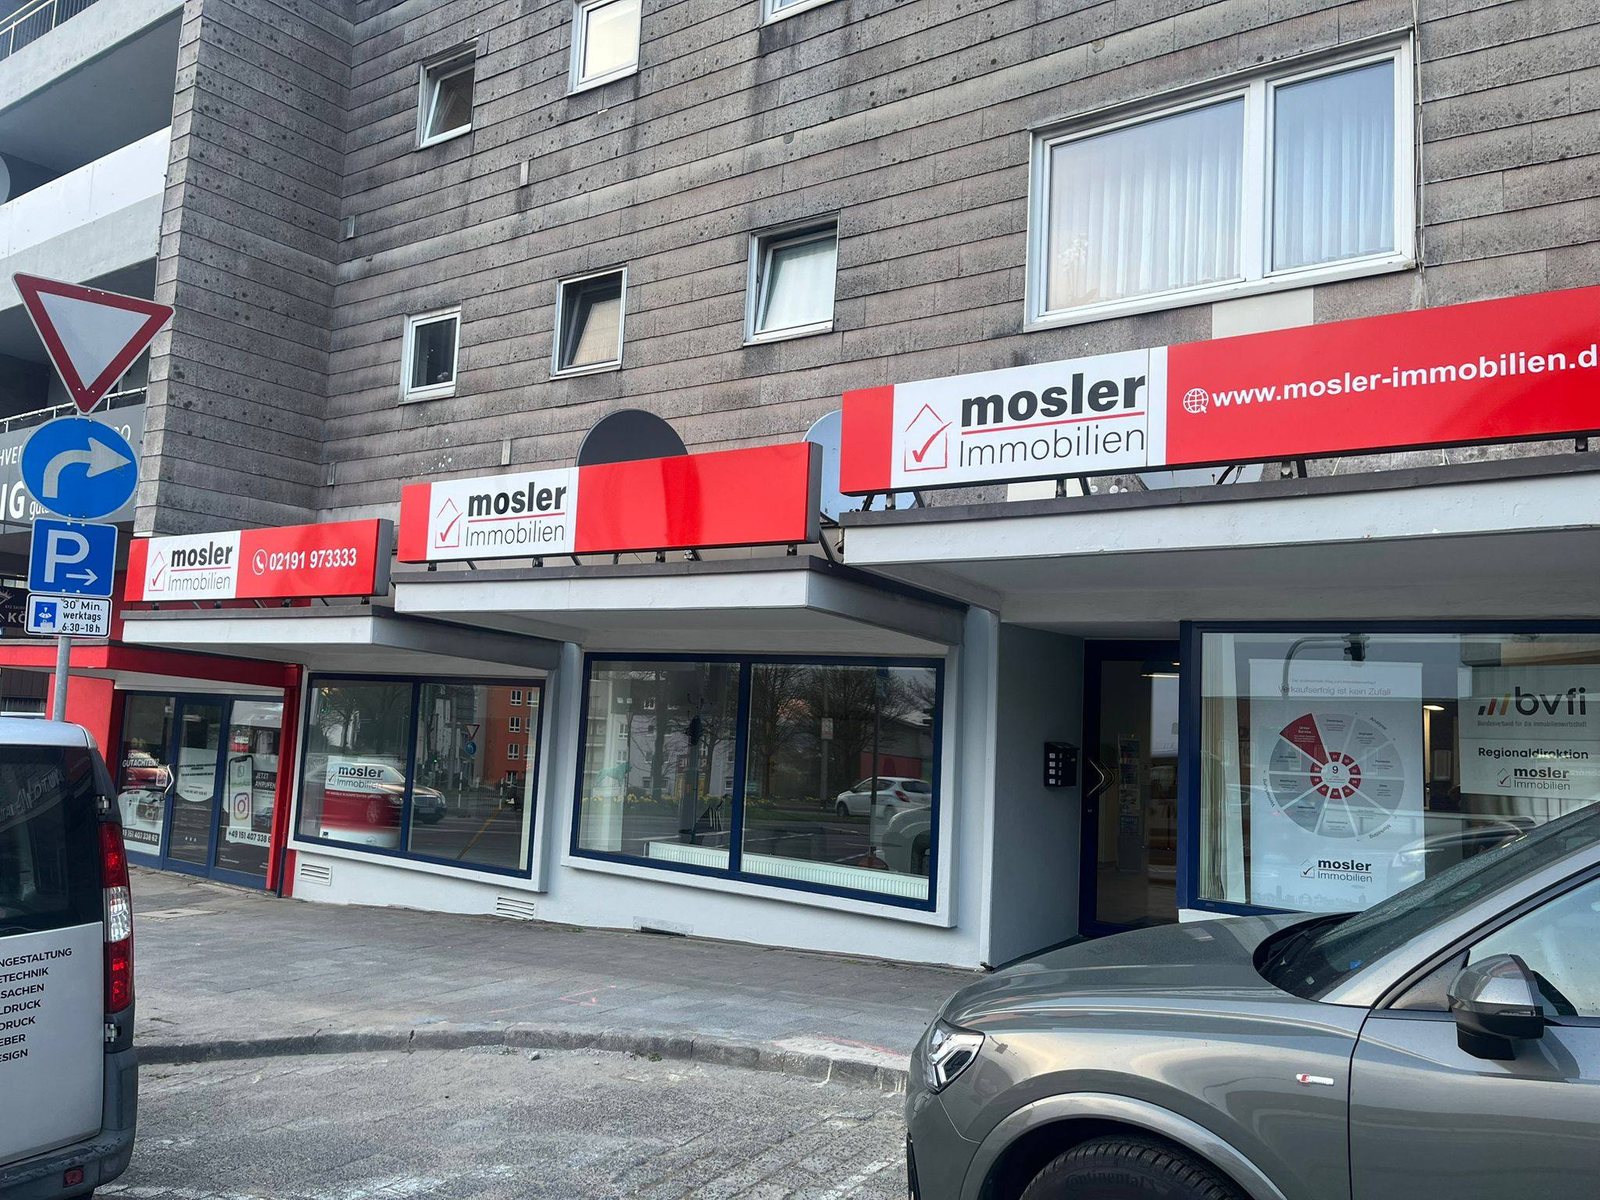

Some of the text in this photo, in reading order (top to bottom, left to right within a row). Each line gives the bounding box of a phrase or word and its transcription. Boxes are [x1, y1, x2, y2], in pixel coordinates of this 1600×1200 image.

[1212, 343, 1598, 408] www.mosler-immobilien.d
[961, 373, 1146, 428] mosler
[959, 424, 1145, 468] Immobilien
[468, 482, 567, 517] mosler
[465, 521, 565, 547] Immobilien
[44, 529, 90, 584] P
[171, 541, 233, 567] mosler
[269, 548, 357, 571] 02191 973333
[167, 571, 231, 592] Immobilien
[62, 600, 103, 612] 30 Min.
[62, 611, 102, 623] werktags
[1515, 686, 1587, 716] bvfi
[1478, 747, 1589, 760] Regionaldirektion
[338, 766, 384, 778] mosler
[1332, 765, 1339, 774] 9
[1513, 766, 1570, 779] mosler
[1513, 780, 1571, 791] Immobilien
[1318, 860, 1372, 872] mosler
[1318, 870, 1373, 883] Immobilien
[0, 984, 45, 999] SACHEN
